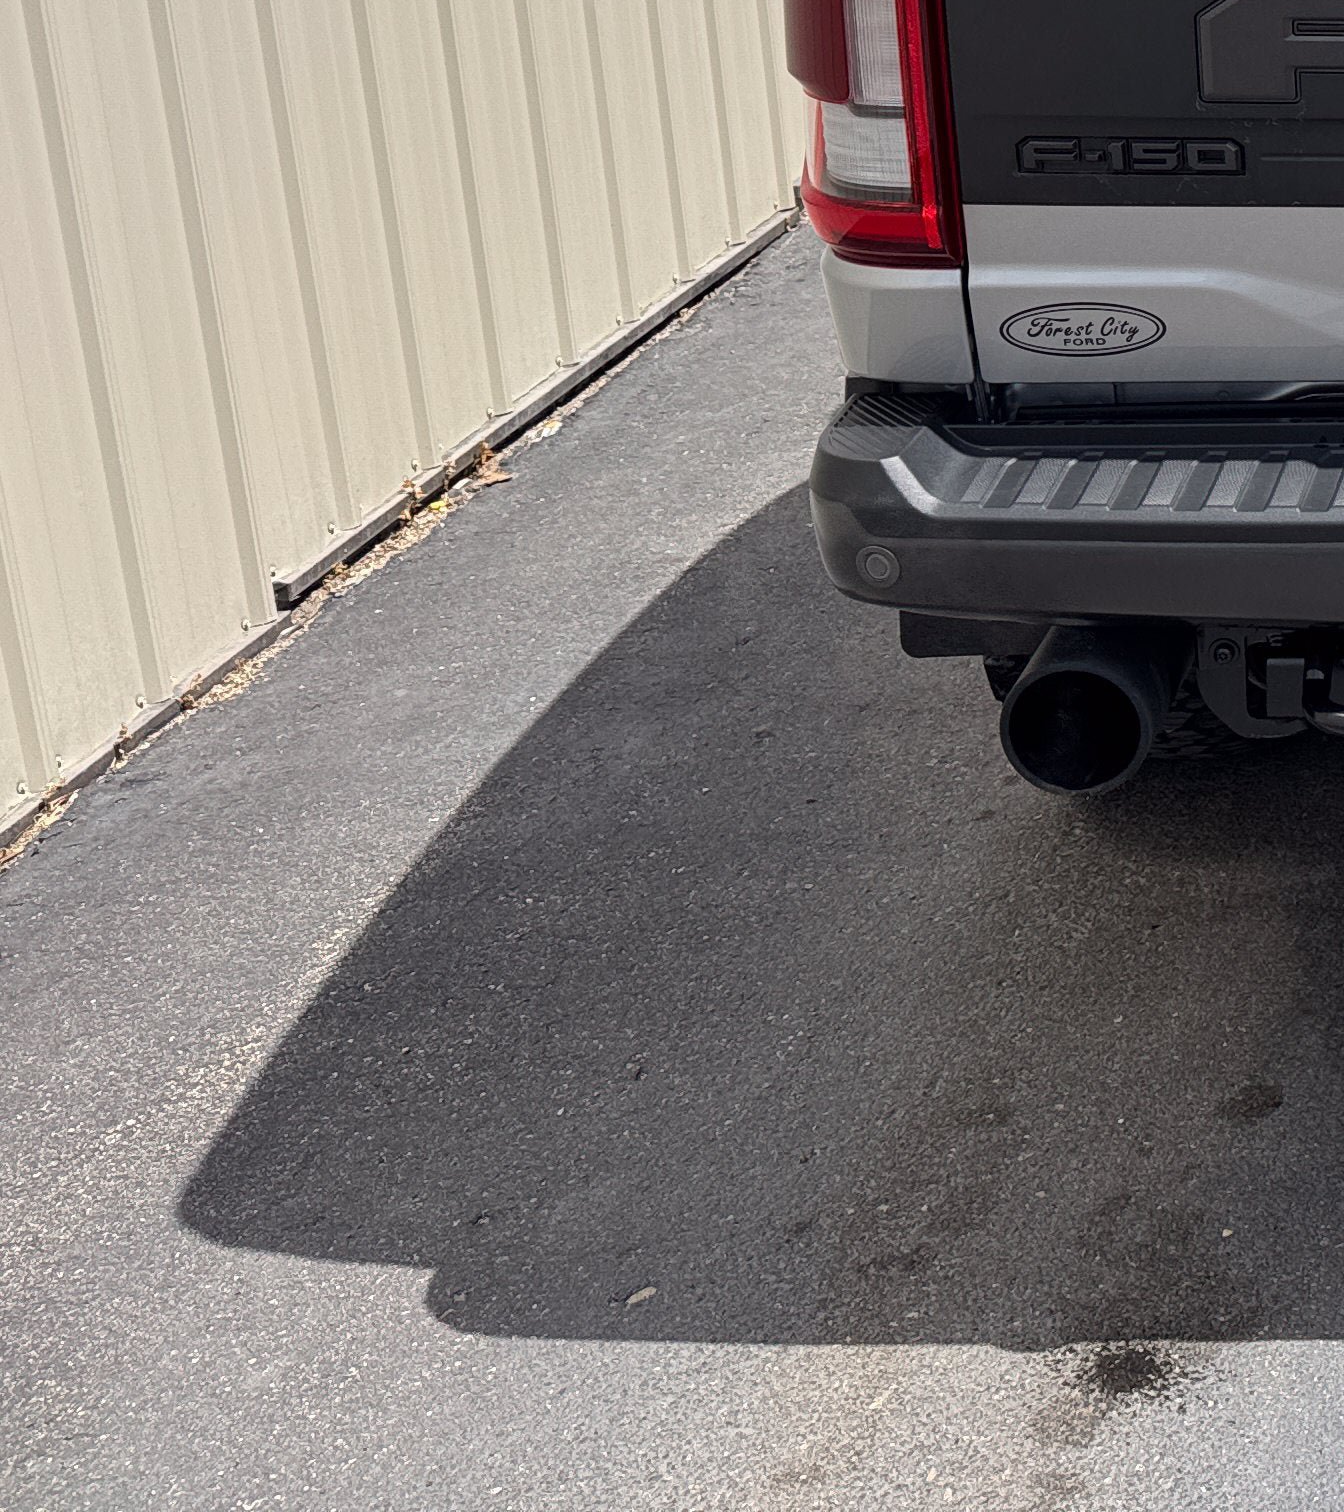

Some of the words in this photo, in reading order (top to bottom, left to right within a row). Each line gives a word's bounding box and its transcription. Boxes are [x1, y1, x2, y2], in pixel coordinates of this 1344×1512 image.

[1016, 136, 1246, 176] F-150
[1027, 317, 1094, 337] Forest
[1101, 316, 1140, 342] City
[1063, 338, 1107, 346] FORD
